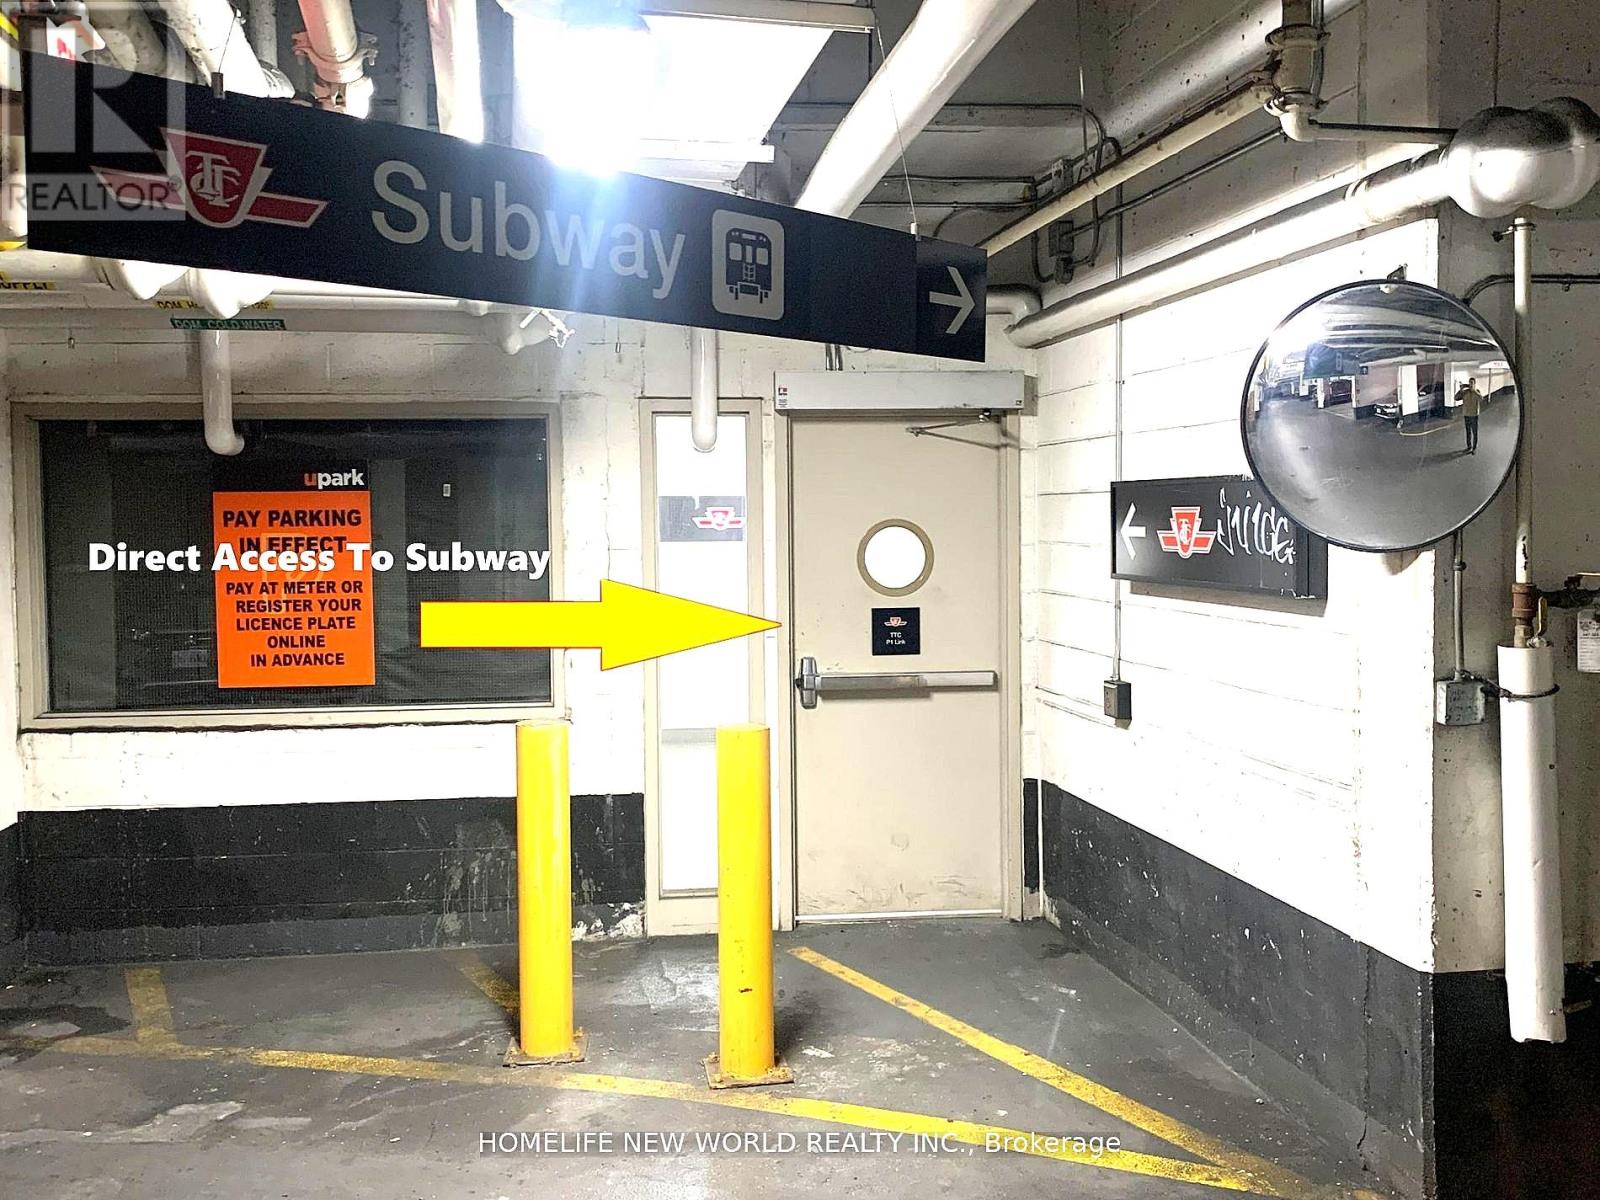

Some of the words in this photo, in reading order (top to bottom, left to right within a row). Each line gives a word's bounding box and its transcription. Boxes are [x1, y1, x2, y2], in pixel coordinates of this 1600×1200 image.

[371, 160, 685, 300] Subway
[206, 320, 241, 330] COLD
[241, 320, 281, 330] WATER
[303, 468, 365, 490] upark
[223, 509, 261, 528] PAY
[268, 509, 362, 527] PARKING
[268, 536, 347, 553] EFFECT
[226, 582, 254, 595] PAY
[259, 582, 278, 595] AT
[284, 581, 337, 594] METER
[341, 580, 364, 594] OR
[236, 600, 313, 613] REGISTER
[317, 599, 362, 612] YOUR
[236, 617, 303, 631] LICENCE
[307, 616, 356, 630] PLATE
[267, 635, 326, 649] ONLINE
[251, 654, 267, 667] IN
[271, 653, 345, 667] ADVANCE
